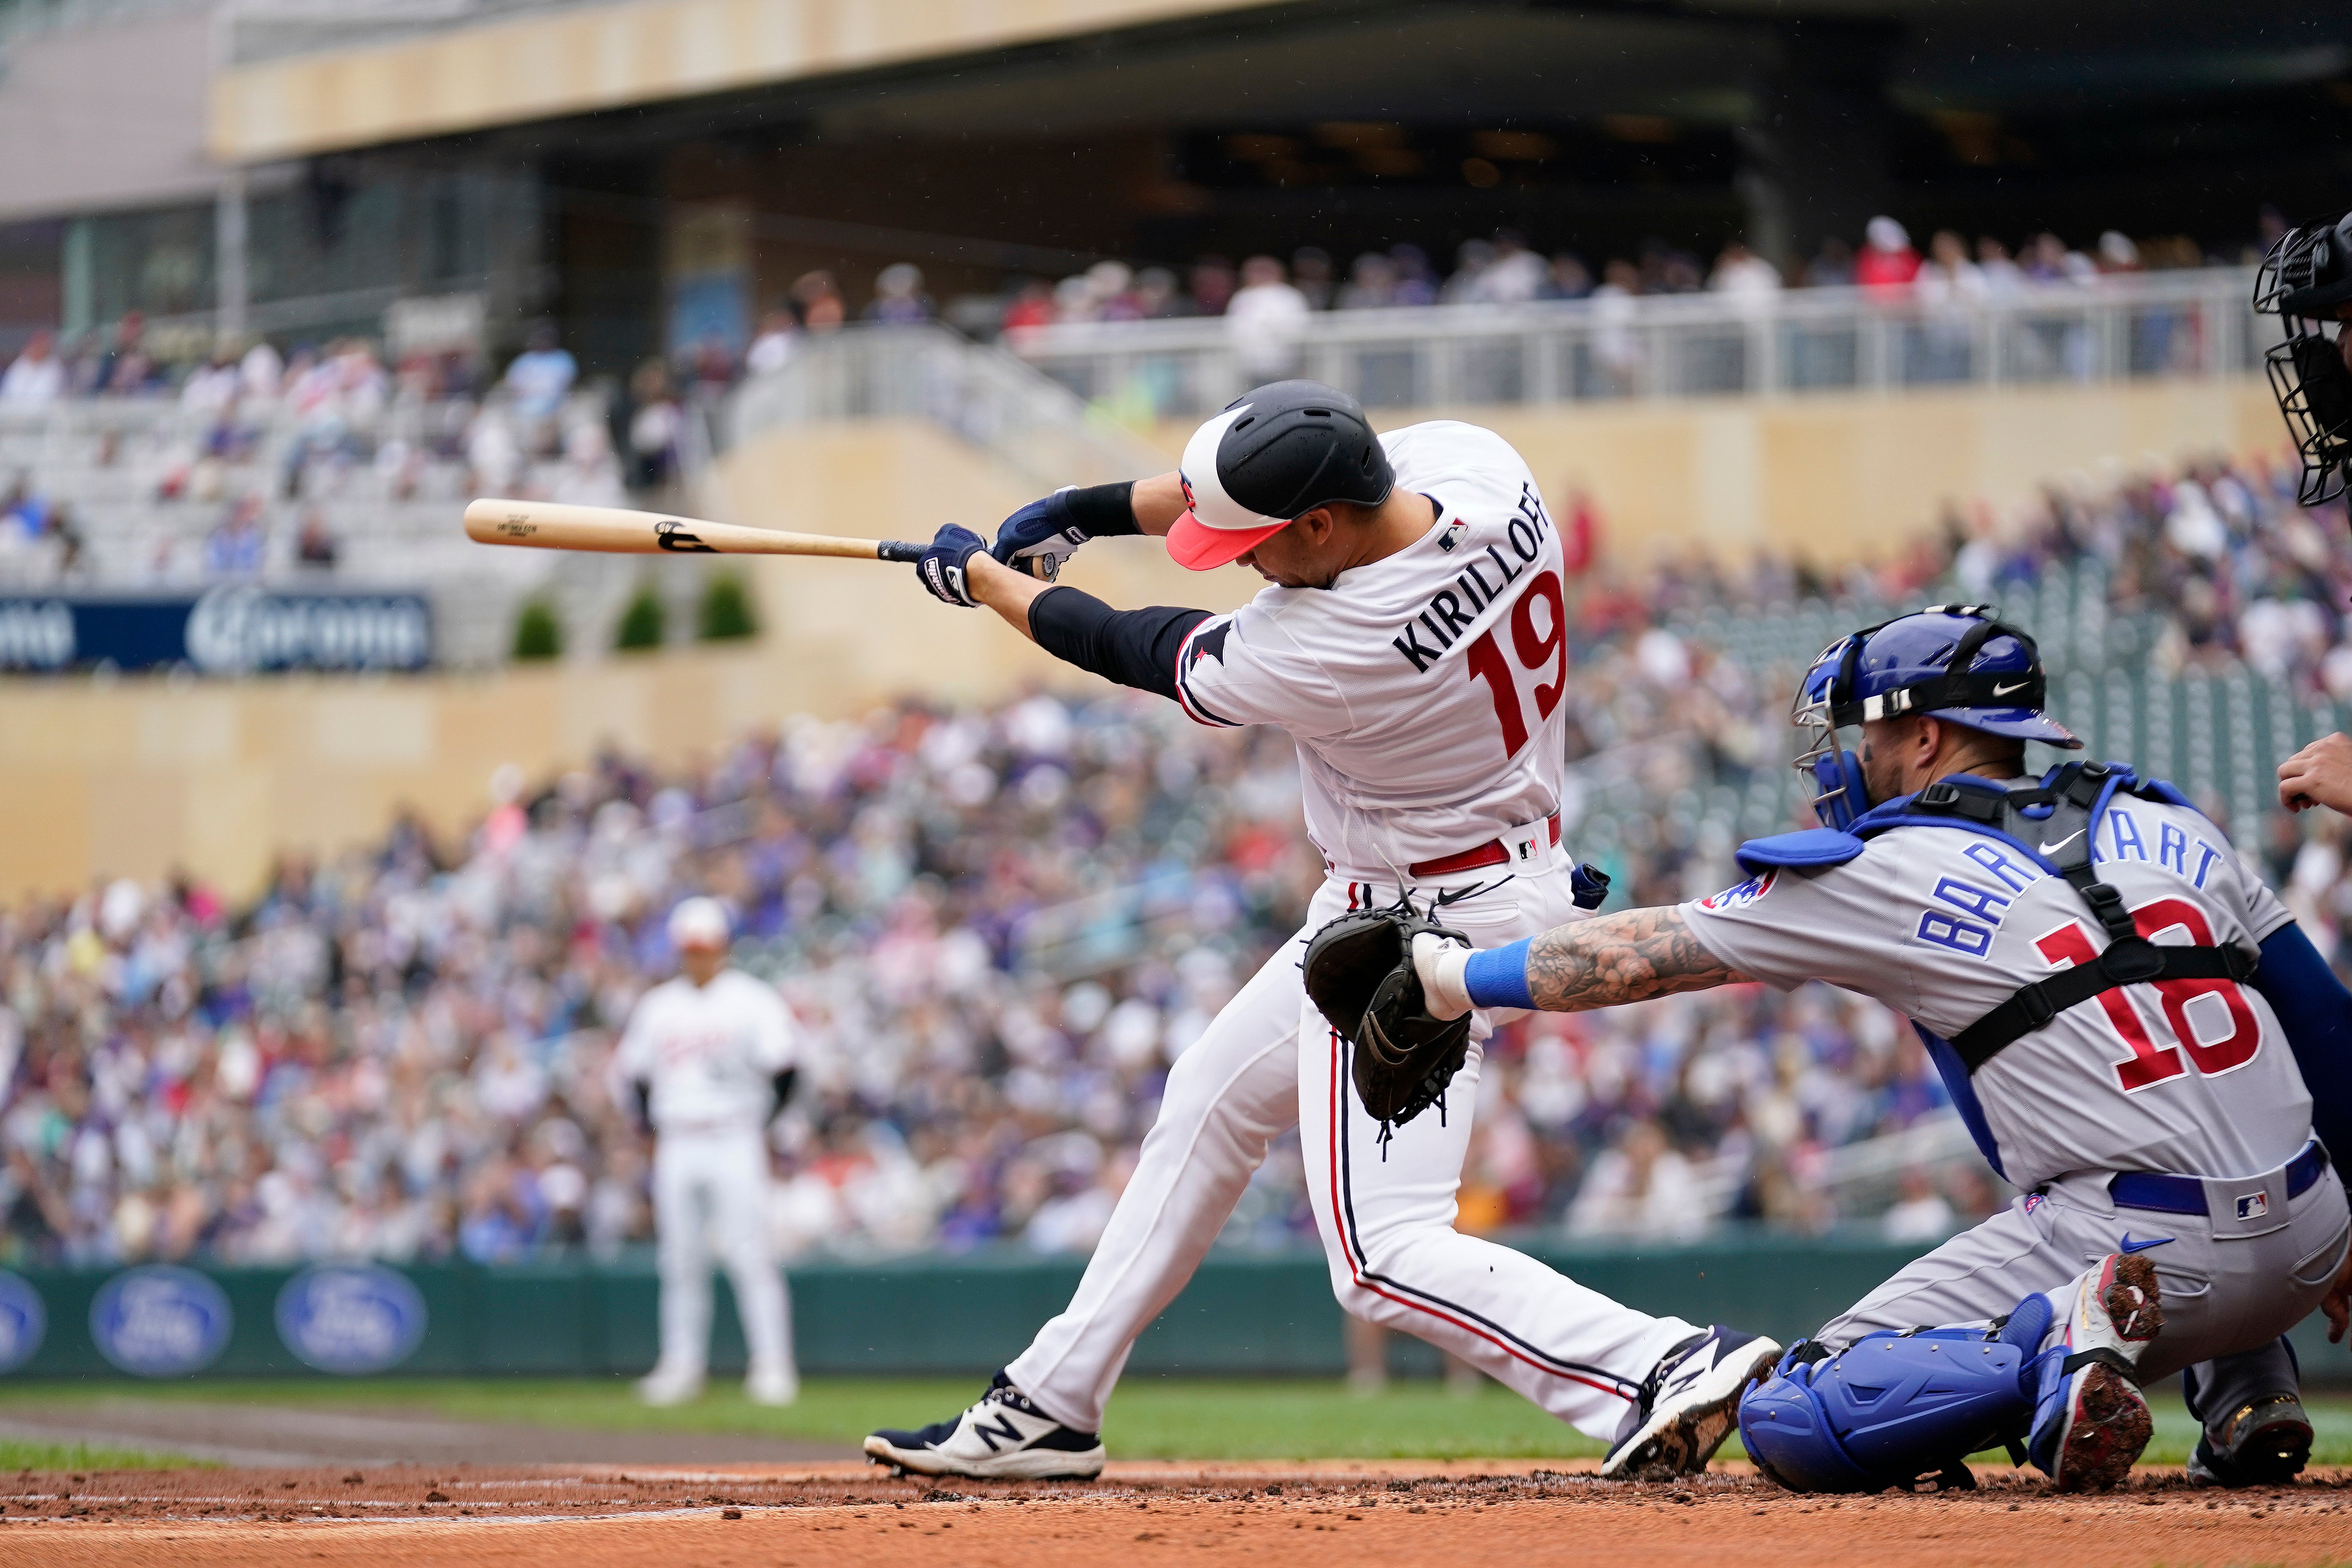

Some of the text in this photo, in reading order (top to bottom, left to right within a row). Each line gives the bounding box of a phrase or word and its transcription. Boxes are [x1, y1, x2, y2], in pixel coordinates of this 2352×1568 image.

[1392, 479, 1548, 674] KIRILLOFF
[1467, 570, 1566, 760] 19
[1914, 807, 2224, 960] BARART
[2029, 894, 2264, 1094] 18
